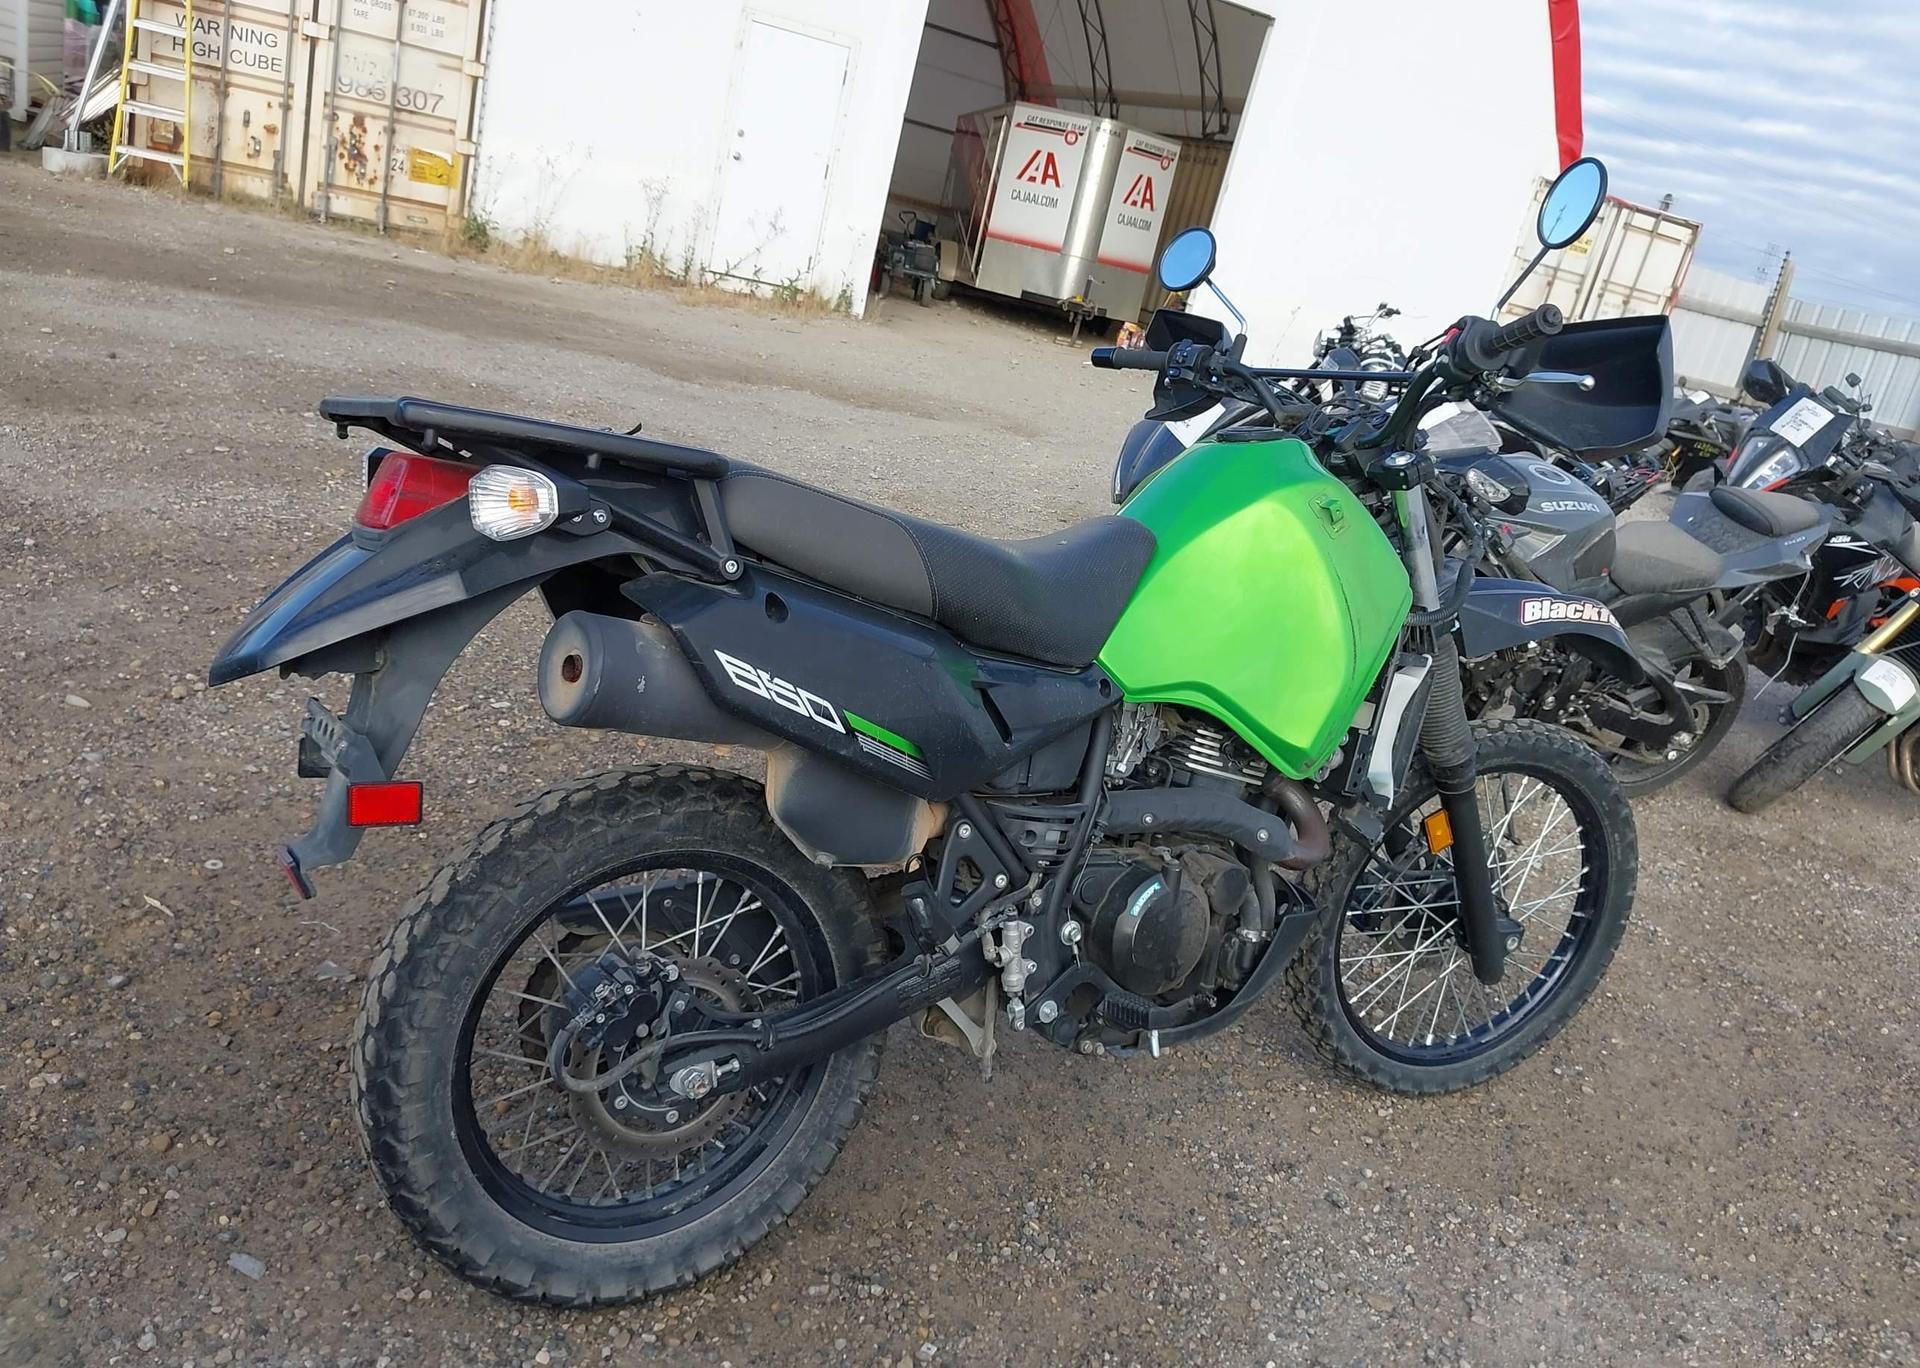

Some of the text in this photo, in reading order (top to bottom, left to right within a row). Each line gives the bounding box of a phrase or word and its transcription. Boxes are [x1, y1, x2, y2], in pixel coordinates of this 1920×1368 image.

[175, 13, 278, 48] WARNING
[172, 36, 283, 73] HGH CUBE
[396, 86, 444, 113] 307
[1026, 114, 1088, 131] CAT RESPONSE TEAM
[1540, 501, 1600, 513] SUZUKI
[1829, 534, 1852, 544] KTM
[713, 648, 847, 735] 650
